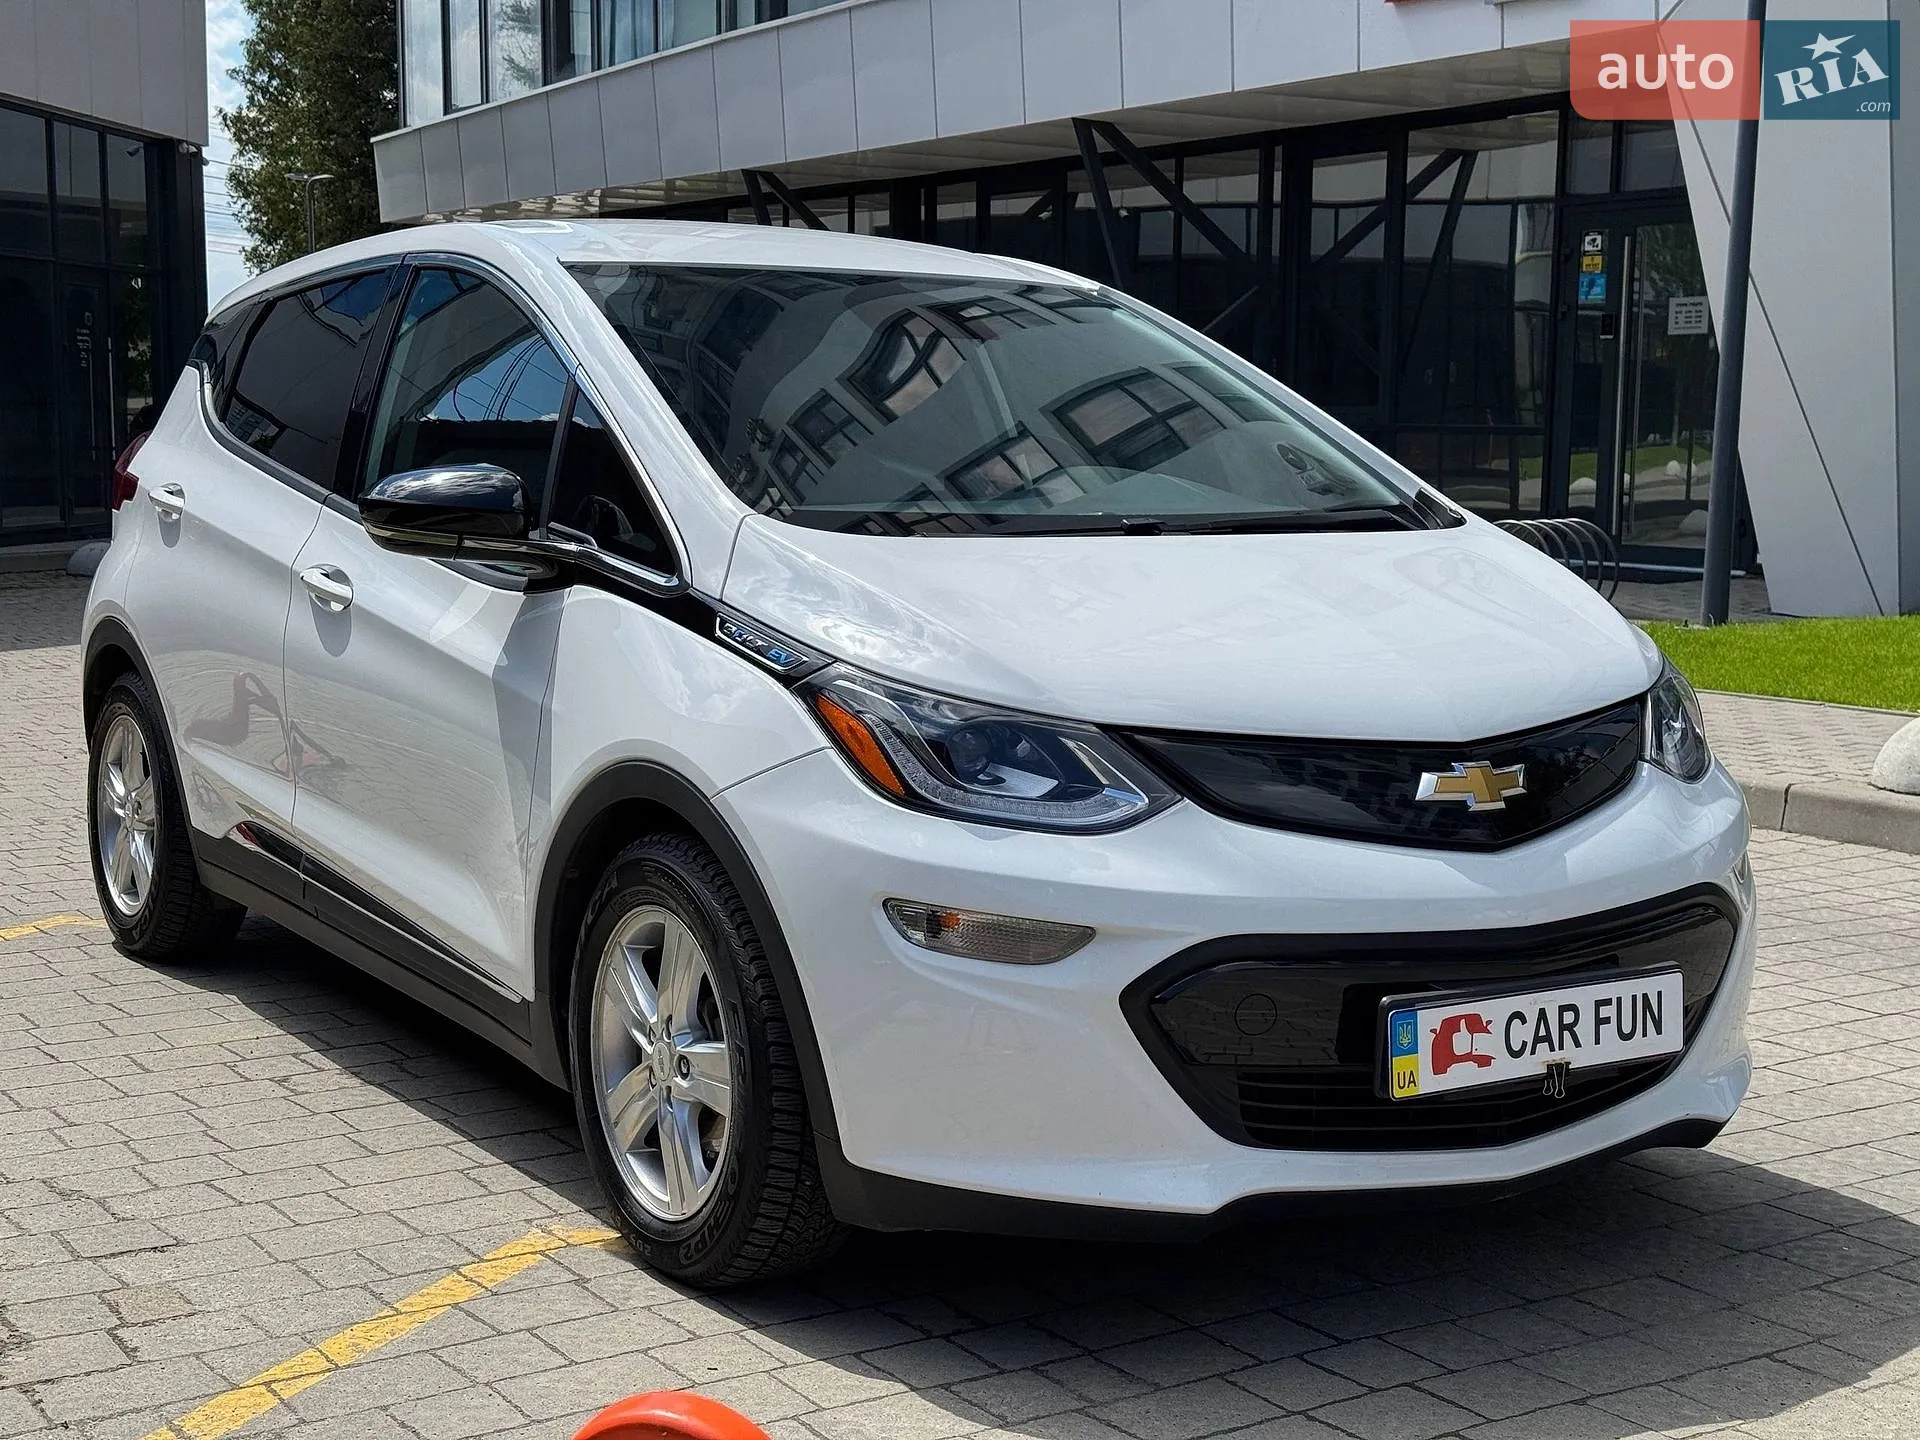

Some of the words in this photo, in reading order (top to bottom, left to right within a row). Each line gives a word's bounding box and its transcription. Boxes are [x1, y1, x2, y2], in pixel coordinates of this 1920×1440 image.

[723, 622, 769, 648] BOLT
[767, 647, 796, 665] EV
[1503, 1003, 1583, 1060] CAR
[1593, 990, 1664, 1047] FUN
[1396, 1070, 1418, 1090] UA
